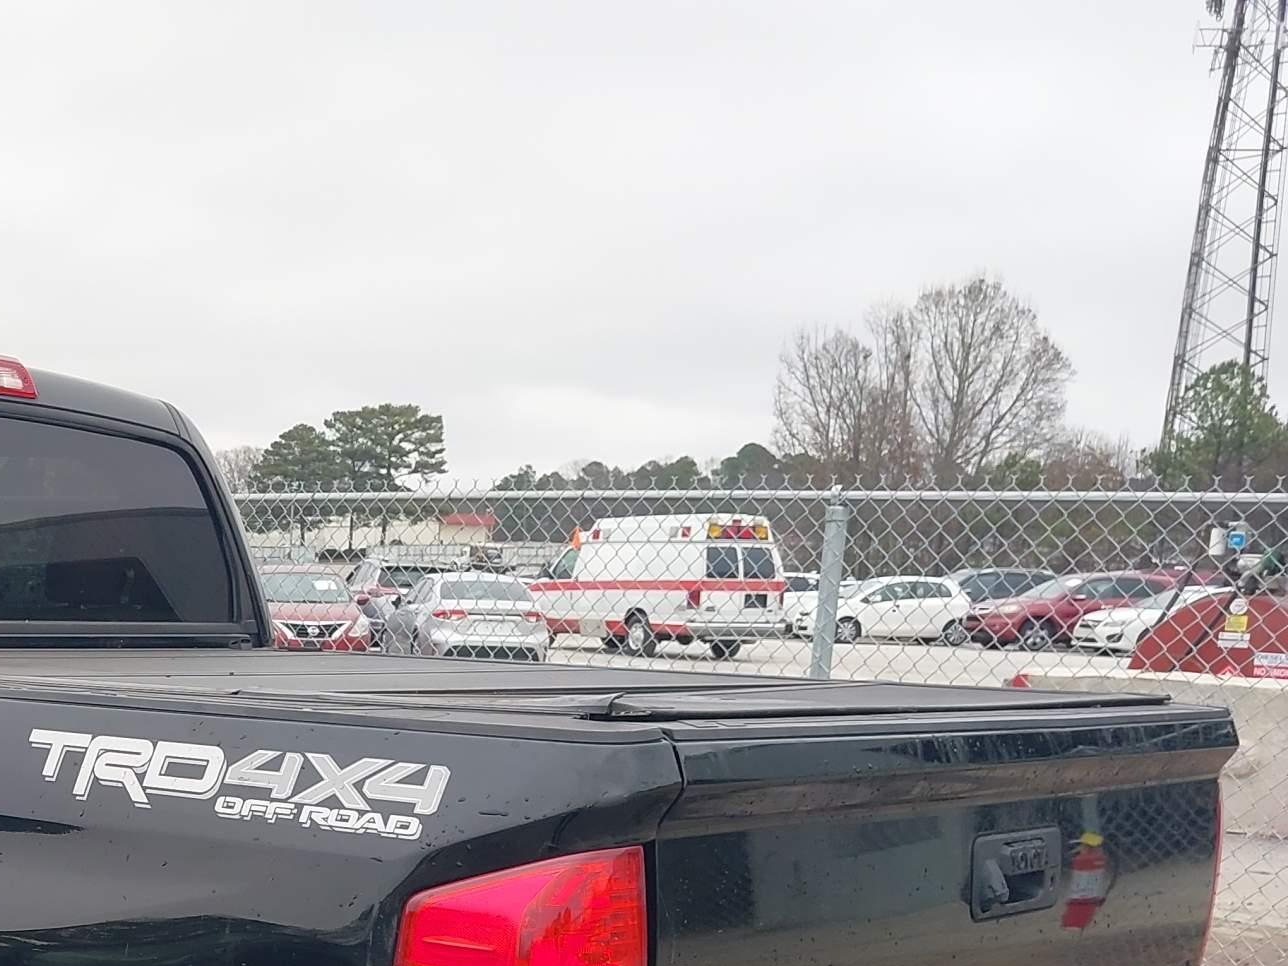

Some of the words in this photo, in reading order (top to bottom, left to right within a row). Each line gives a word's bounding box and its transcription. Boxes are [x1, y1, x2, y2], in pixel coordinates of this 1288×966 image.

[28, 729, 227, 808] TRD
[214, 796, 297, 822] OFF
[299, 806, 422, 840] ROAD
